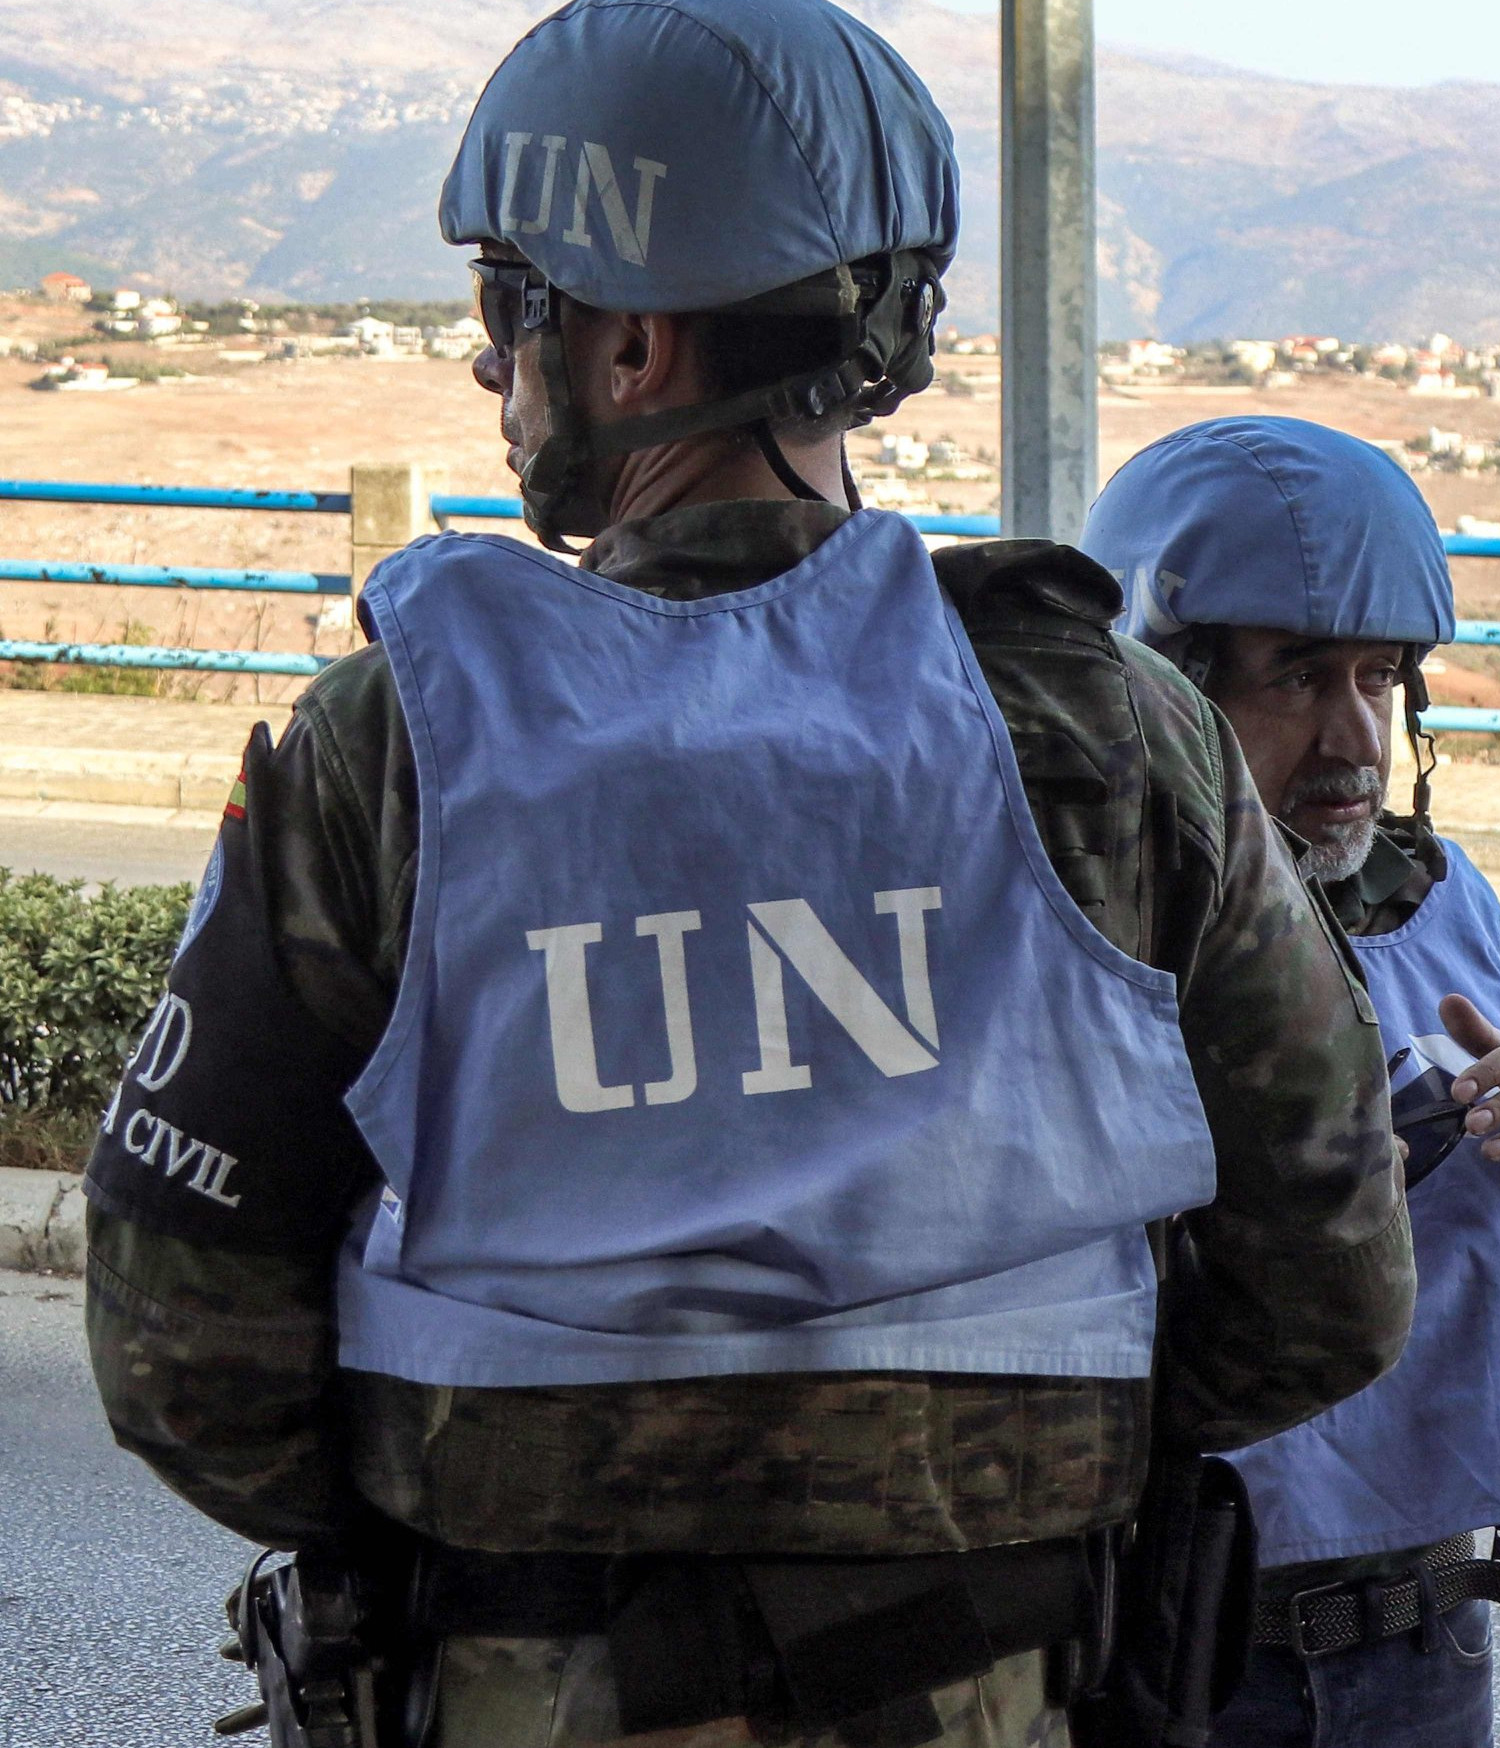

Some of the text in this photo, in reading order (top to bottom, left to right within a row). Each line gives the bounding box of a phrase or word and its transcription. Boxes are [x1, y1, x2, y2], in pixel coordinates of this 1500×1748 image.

[501, 131, 668, 267] UN
[525, 886, 943, 1114] UN
[125, 1108, 243, 1208] CIVIL
